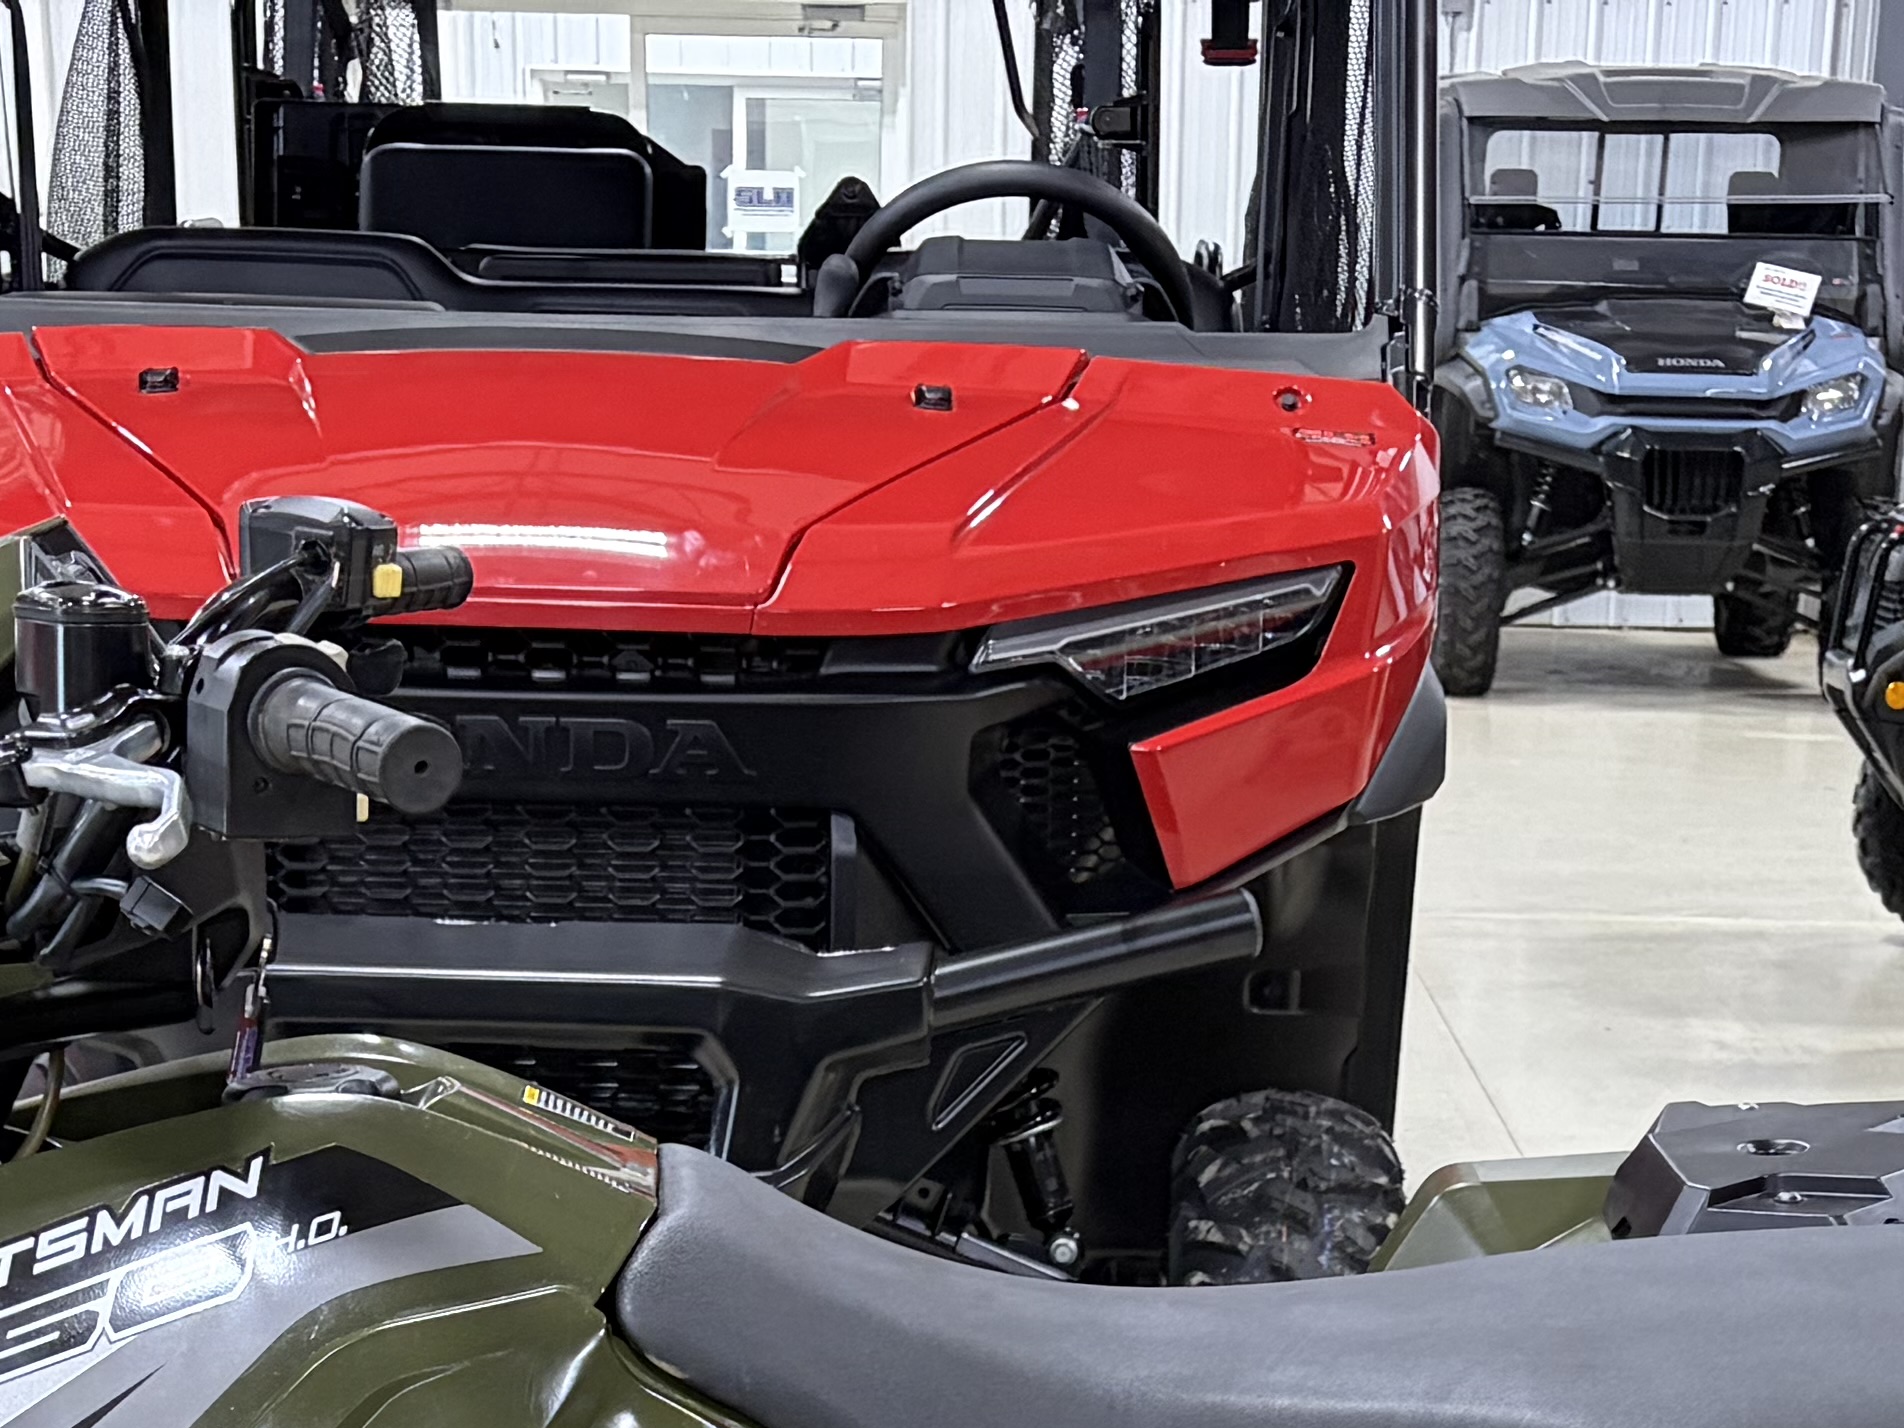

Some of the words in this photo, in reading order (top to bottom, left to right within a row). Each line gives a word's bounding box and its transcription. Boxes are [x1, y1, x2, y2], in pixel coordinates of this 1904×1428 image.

[1657, 357, 1726, 368] HONDA
[454, 715, 758, 776] NDA
[270, 1209, 348, 1254] H.O.
